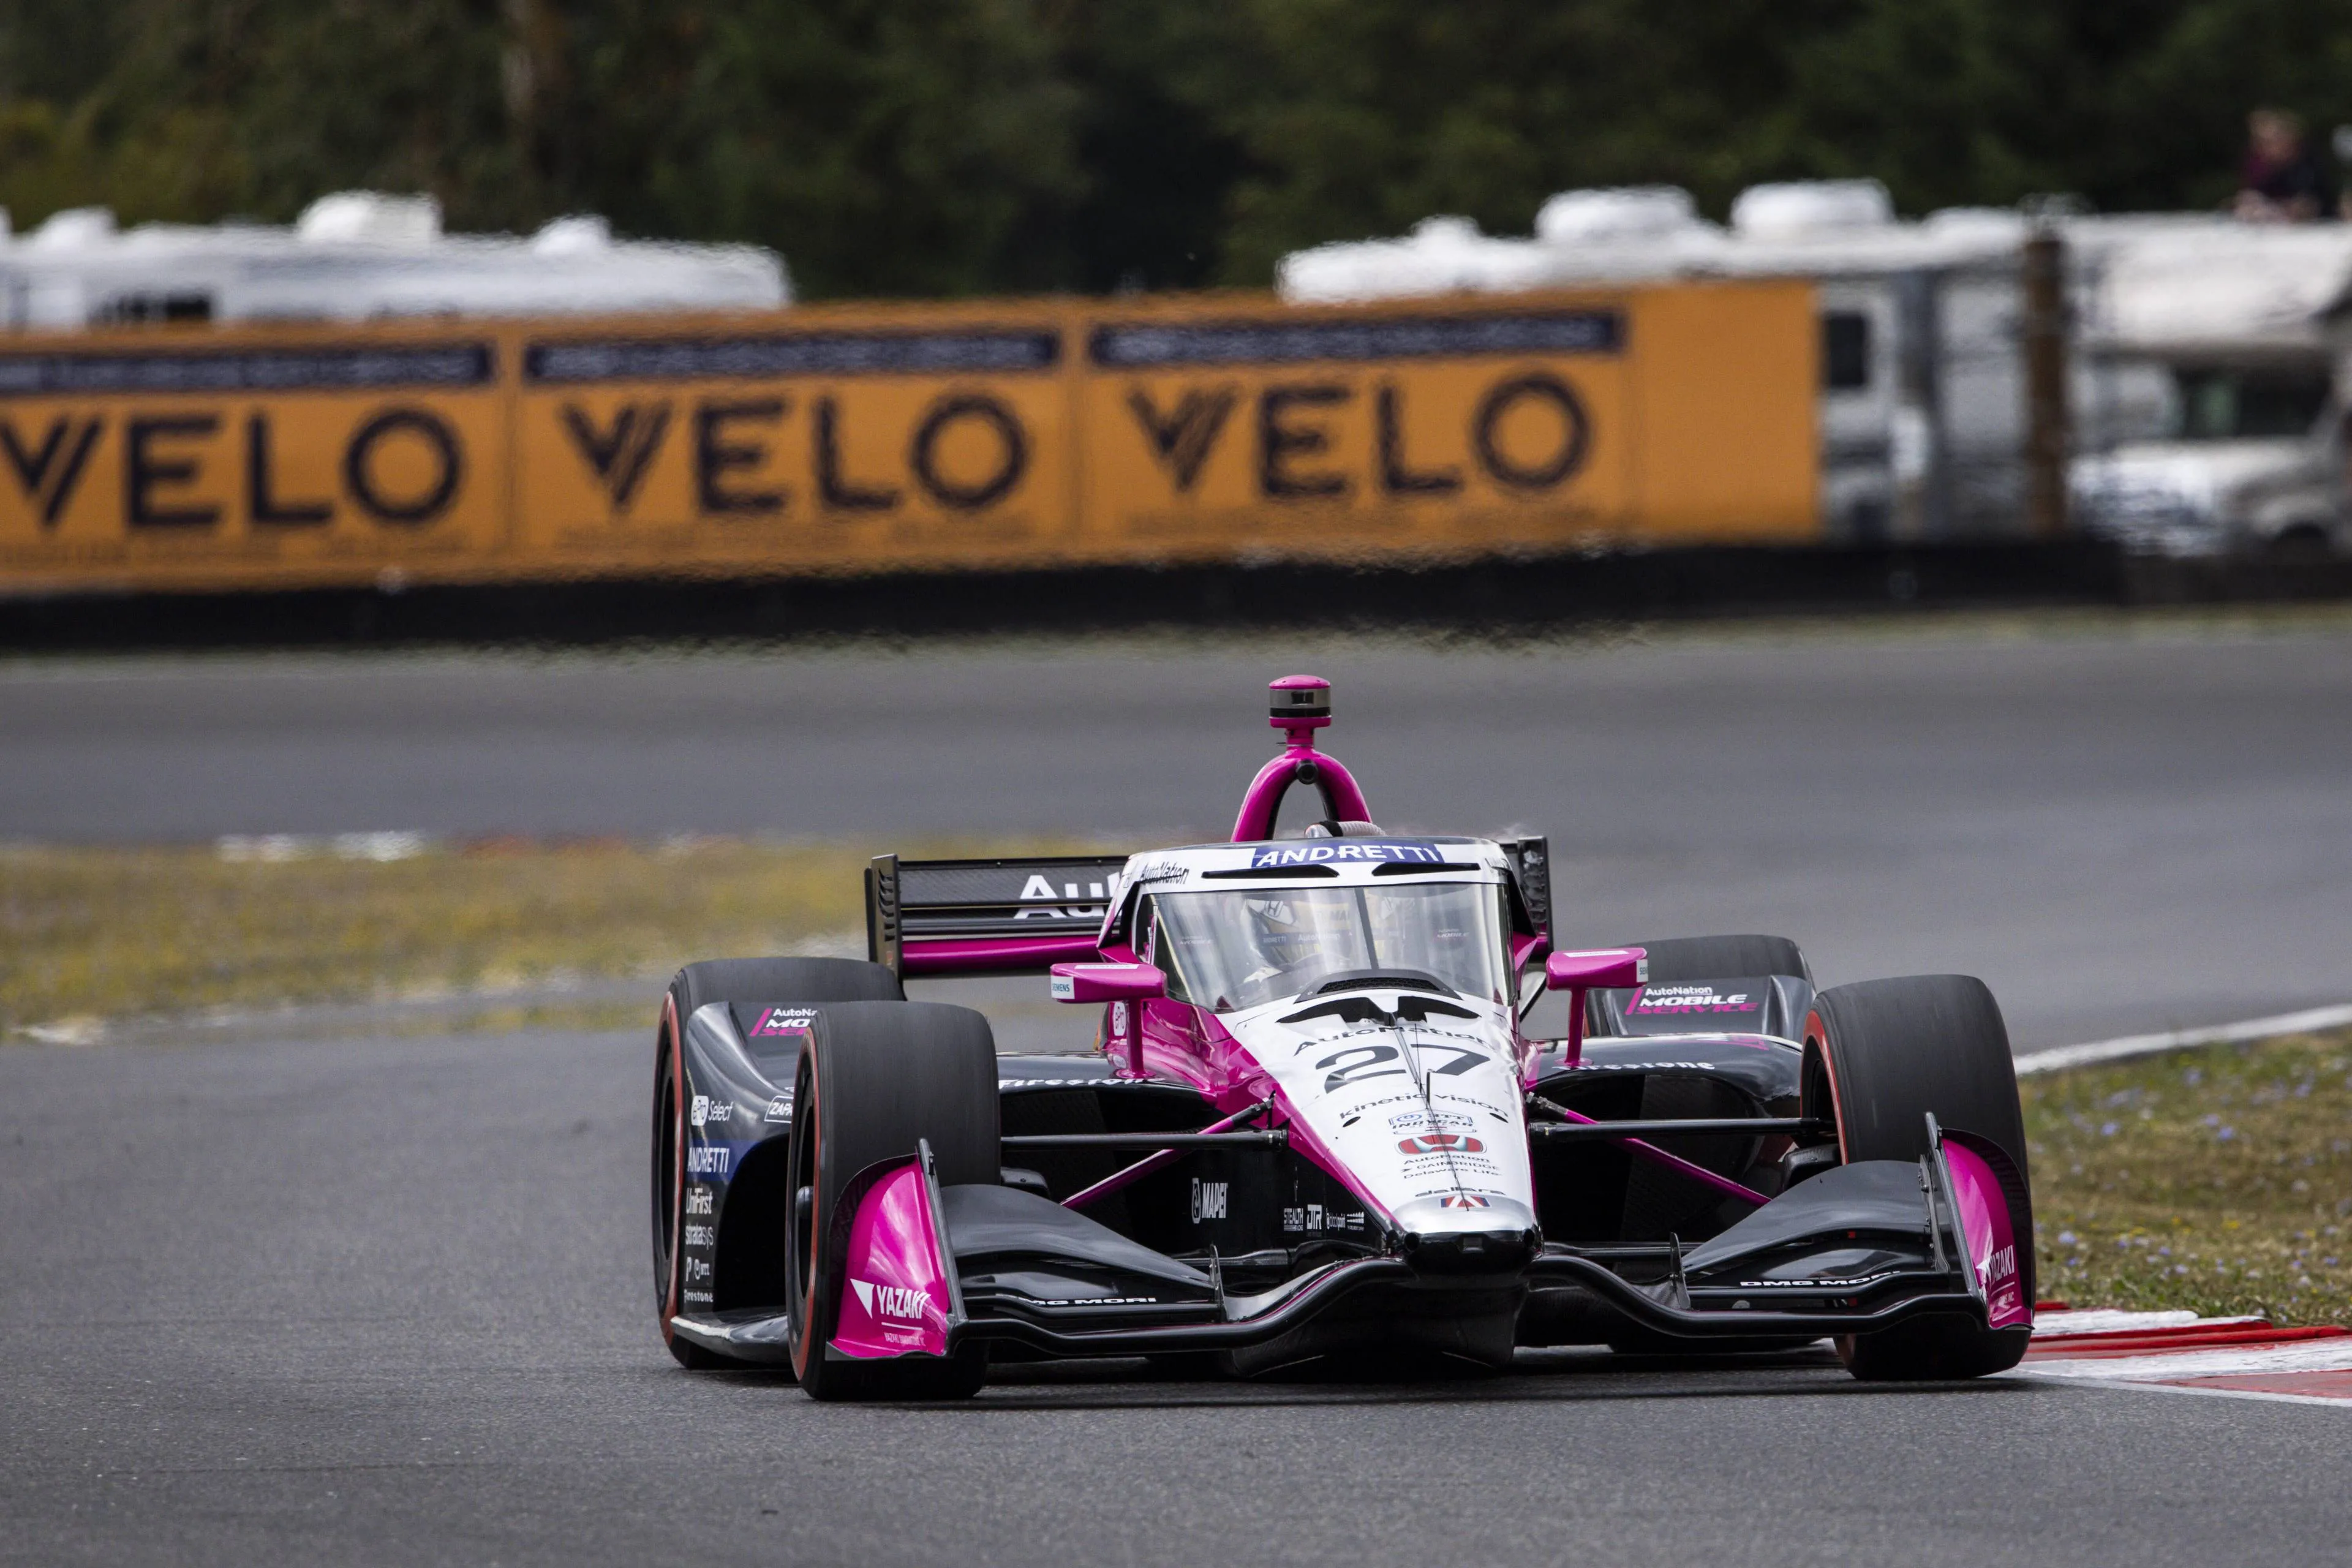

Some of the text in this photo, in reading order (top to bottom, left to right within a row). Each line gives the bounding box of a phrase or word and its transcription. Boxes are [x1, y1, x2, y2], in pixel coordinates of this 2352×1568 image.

[1126, 372, 1594, 494] VELO
[560, 393, 1029, 512] VELO
[0, 407, 463, 529] VELO
[1256, 844, 1439, 867] ANDRETTI
[1140, 862, 1190, 886] AutoNation
[1639, 994, 1747, 1006] MOBILE
[1645, 986, 1713, 996] AutoNation
[1635, 1002, 1758, 1014] SERVICE
[1316, 1043, 1491, 1094] 27
[708, 1100, 734, 1121] Select
[1340, 1093, 1509, 1119] kinetic vision
[687, 1147, 730, 1173] ANDRETTI
[1404, 1155, 1490, 1165] AutoNation
[1404, 1168, 1469, 1179] Delaware
[686, 1188, 713, 1214] UniFirst
[1202, 1182, 1229, 1218] MAPEI
[1415, 1186, 1507, 1197] dallara
[1284, 1208, 1303, 1224] STEALTH
[685, 1224, 714, 1250] stratasys
[684, 1289, 714, 1303] Firestone
[876, 1285, 932, 1319] YAZAKI
